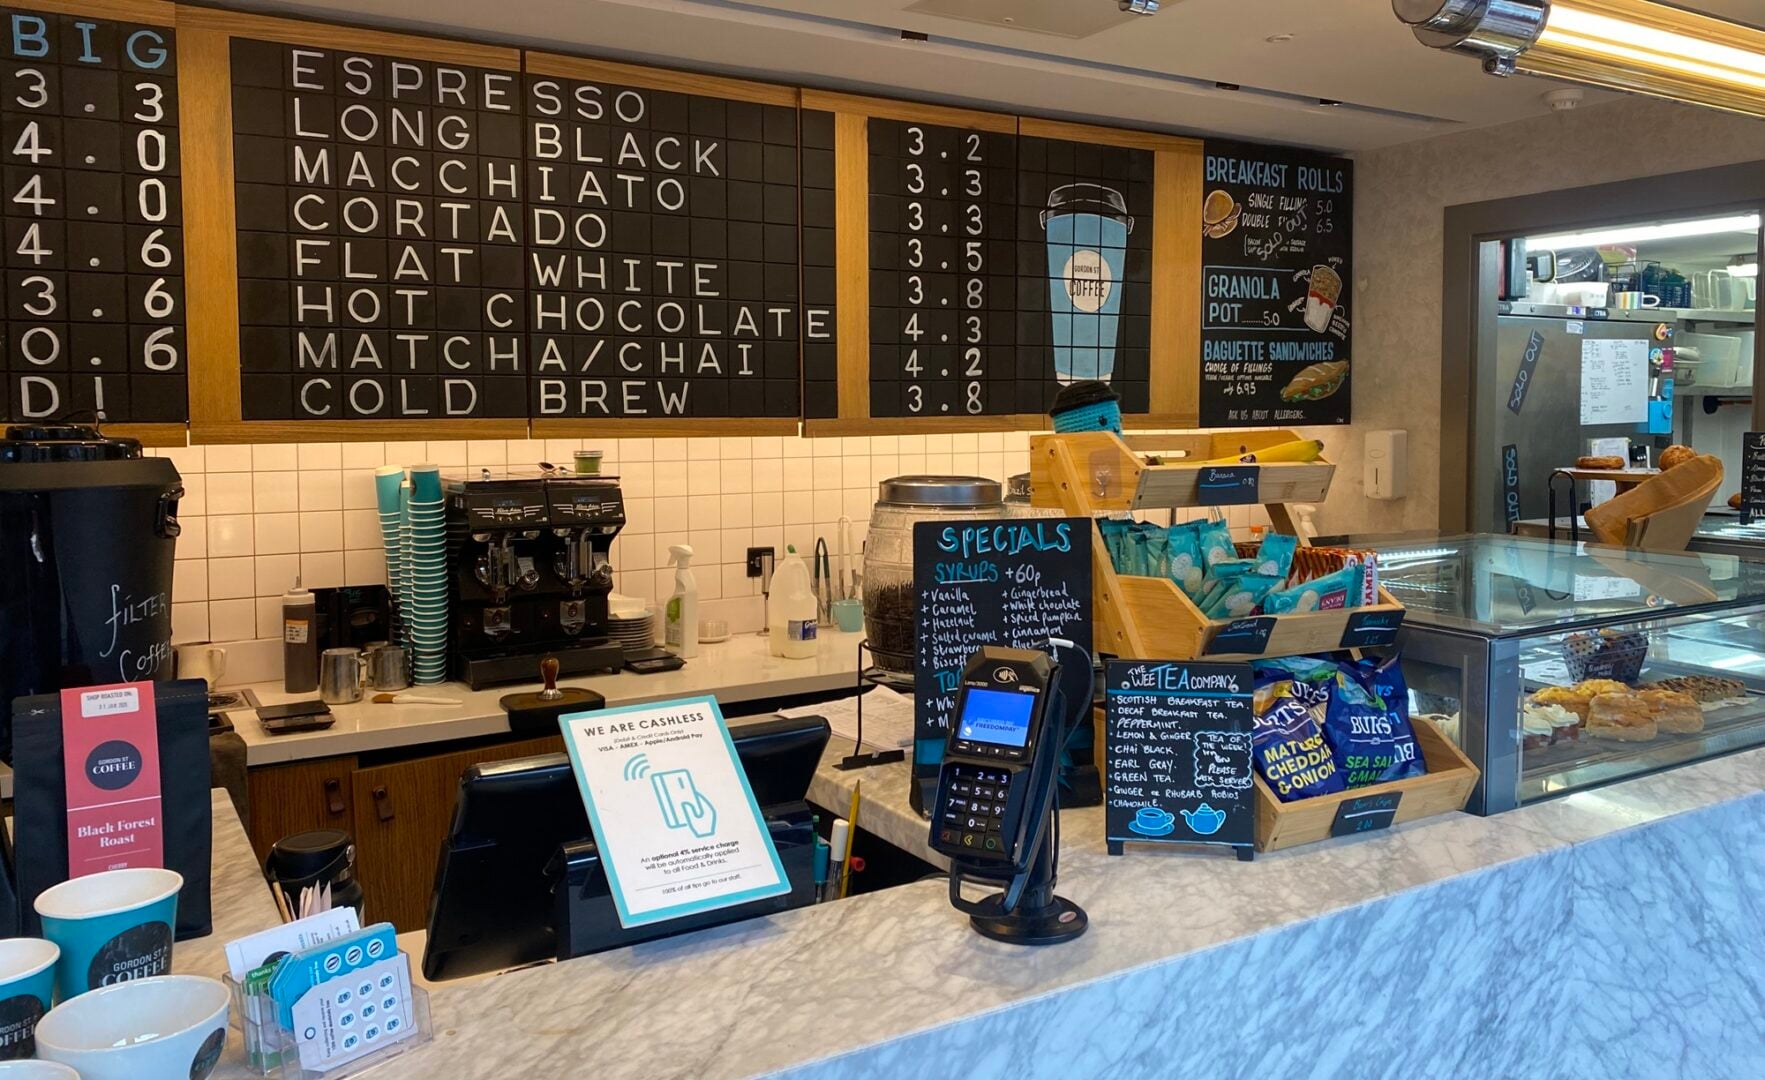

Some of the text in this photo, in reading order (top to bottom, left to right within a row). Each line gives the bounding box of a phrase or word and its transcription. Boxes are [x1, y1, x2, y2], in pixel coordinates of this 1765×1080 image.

[12, 15, 168, 69] BIG
[292, 49, 645, 123] ESPRESSO
[294, 97, 720, 176] LONG BLACK
[295, 146, 685, 211] MACCHIATO
[1206, 156, 1343, 193] BREAKFAST ROLLS
[1248, 192, 1274, 209] SINGLE
[1315, 200, 1333, 215] 5.0
[293, 194, 606, 248] CORTADO
[1242, 212, 1270, 228] DOUBLE
[1316, 219, 1333, 233] 6.5
[295, 240, 720, 296] FLAT WHITE
[1069, 280, 1105, 297] COFFEE
[1208, 274, 1280, 299] GRANOLA
[297, 286, 830, 338] HOT CHOCOLATE
[1209, 303, 1242, 323] POT
[298, 332, 753, 375] MATCHA/CHAI
[1204, 340, 1334, 361] BAGUETTE SANDWICHES
[1526, 328, 1541, 362] OUT
[1205, 362, 1272, 374] CHOICE OF FILLINGS
[300, 377, 688, 416] COLD BREW
[937, 522, 1071, 558] SPECIALS
[934, 561, 998, 583] SYRUPS
[931, 588, 970, 601] Vanilla
[1010, 582, 1069, 600] Gingerbread
[932, 603, 976, 616] Caramel
[1010, 599, 1081, 611] White chocolate
[933, 616, 974, 632] Hazelnut
[1010, 611, 1039, 624] Spiced
[932, 631, 961, 645] Salted
[962, 631, 997, 644] caramel
[1012, 625, 1063, 640] Cinnamon
[933, 645, 981, 657] Strawberr
[1128, 665, 1146, 676] THE
[1131, 663, 1237, 690] WEE TEA COMPANY
[101, 691, 122, 699] ROASTED
[1116, 695, 1219, 708] SCOTTISH BREAKFAST
[1118, 706, 1145, 715] DECAF
[1151, 708, 1198, 718] BREAKFAST
[584, 712, 704, 737] WE ARE CASHLESS
[1116, 731, 1157, 740] LEMON &
[1207, 734, 1224, 743] TEA
[598, 743, 614, 752] VISA
[620, 742, 638, 750] AMEX
[1202, 742, 1215, 750] THE
[1264, 733, 1323, 764] MATURE
[93, 761, 136, 775] COFFEE
[1114, 759, 1140, 769] EARL
[1208, 762, 1237, 775] PLEASE
[1266, 745, 1332, 781] CHEDDAR
[1345, 756, 1393, 769] SEA SAL
[977, 771, 984, 780] 2
[1001, 774, 1008, 783] 3
[1114, 771, 1147, 782] GREEN
[1291, 760, 1336, 789] ONION
[951, 782, 957, 791] 4
[974, 787, 981, 795] 5
[997, 790, 1004, 799] 6
[1114, 785, 1144, 796] GINGER
[1165, 788, 1203, 798] RHUBARB
[949, 798, 955, 807] 7
[971, 803, 978, 811] 8
[994, 806, 1001, 815] 9
[77, 816, 155, 838] Black Forest
[968, 819, 975, 828] 0
[100, 833, 135, 848] Roast
[645, 863, 656, 871] will
[668, 853, 713, 866] automatically
[714, 847, 740, 858] applied
[651, 851, 679, 862] optional
[691, 845, 714, 854] service
[716, 840, 739, 850] charge
[681, 864, 699, 872] Food
[113, 949, 161, 973] GORDON ST
[101, 957, 167, 988] COFFEE
